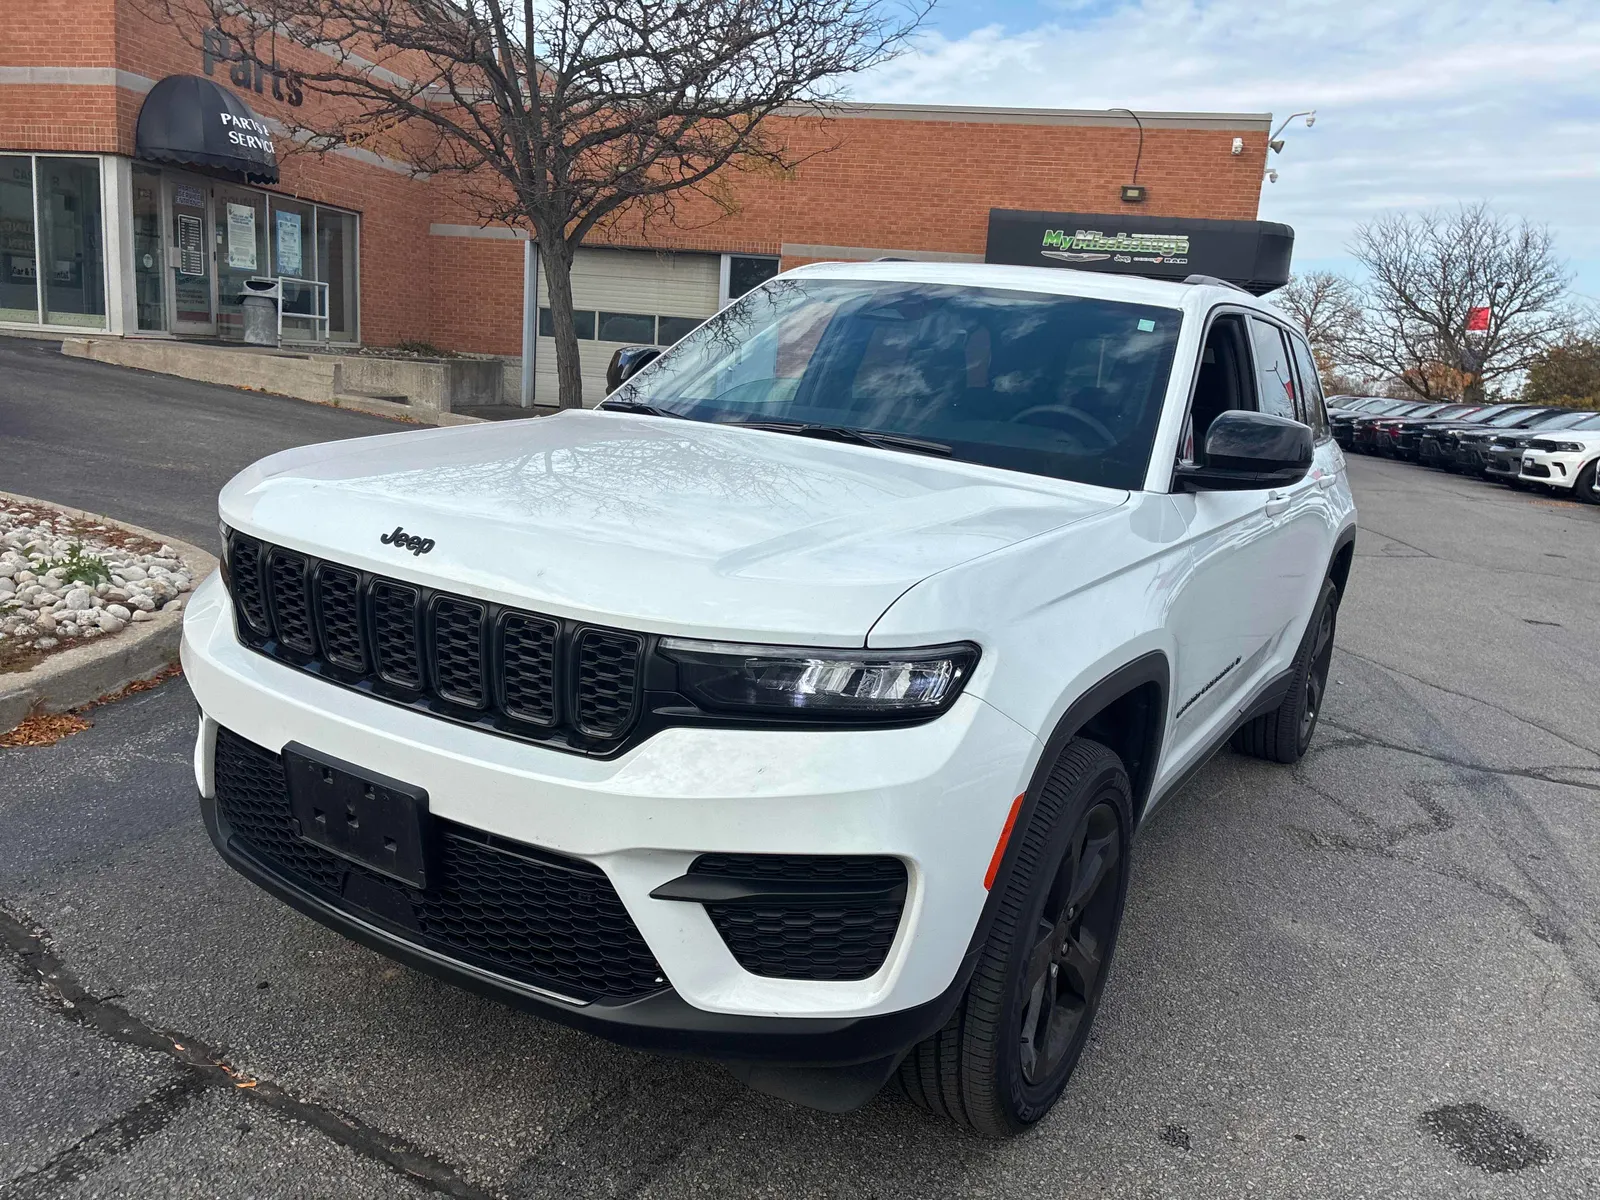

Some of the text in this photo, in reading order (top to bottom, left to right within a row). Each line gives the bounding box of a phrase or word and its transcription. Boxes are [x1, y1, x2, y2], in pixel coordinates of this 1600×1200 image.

[203, 25, 303, 107] Parts
[220, 113, 263, 134] PARTS
[1042, 230, 1189, 256] My Mississauga
[1114, 254, 1131, 263] Jeep
[380, 526, 436, 557] Jeep
